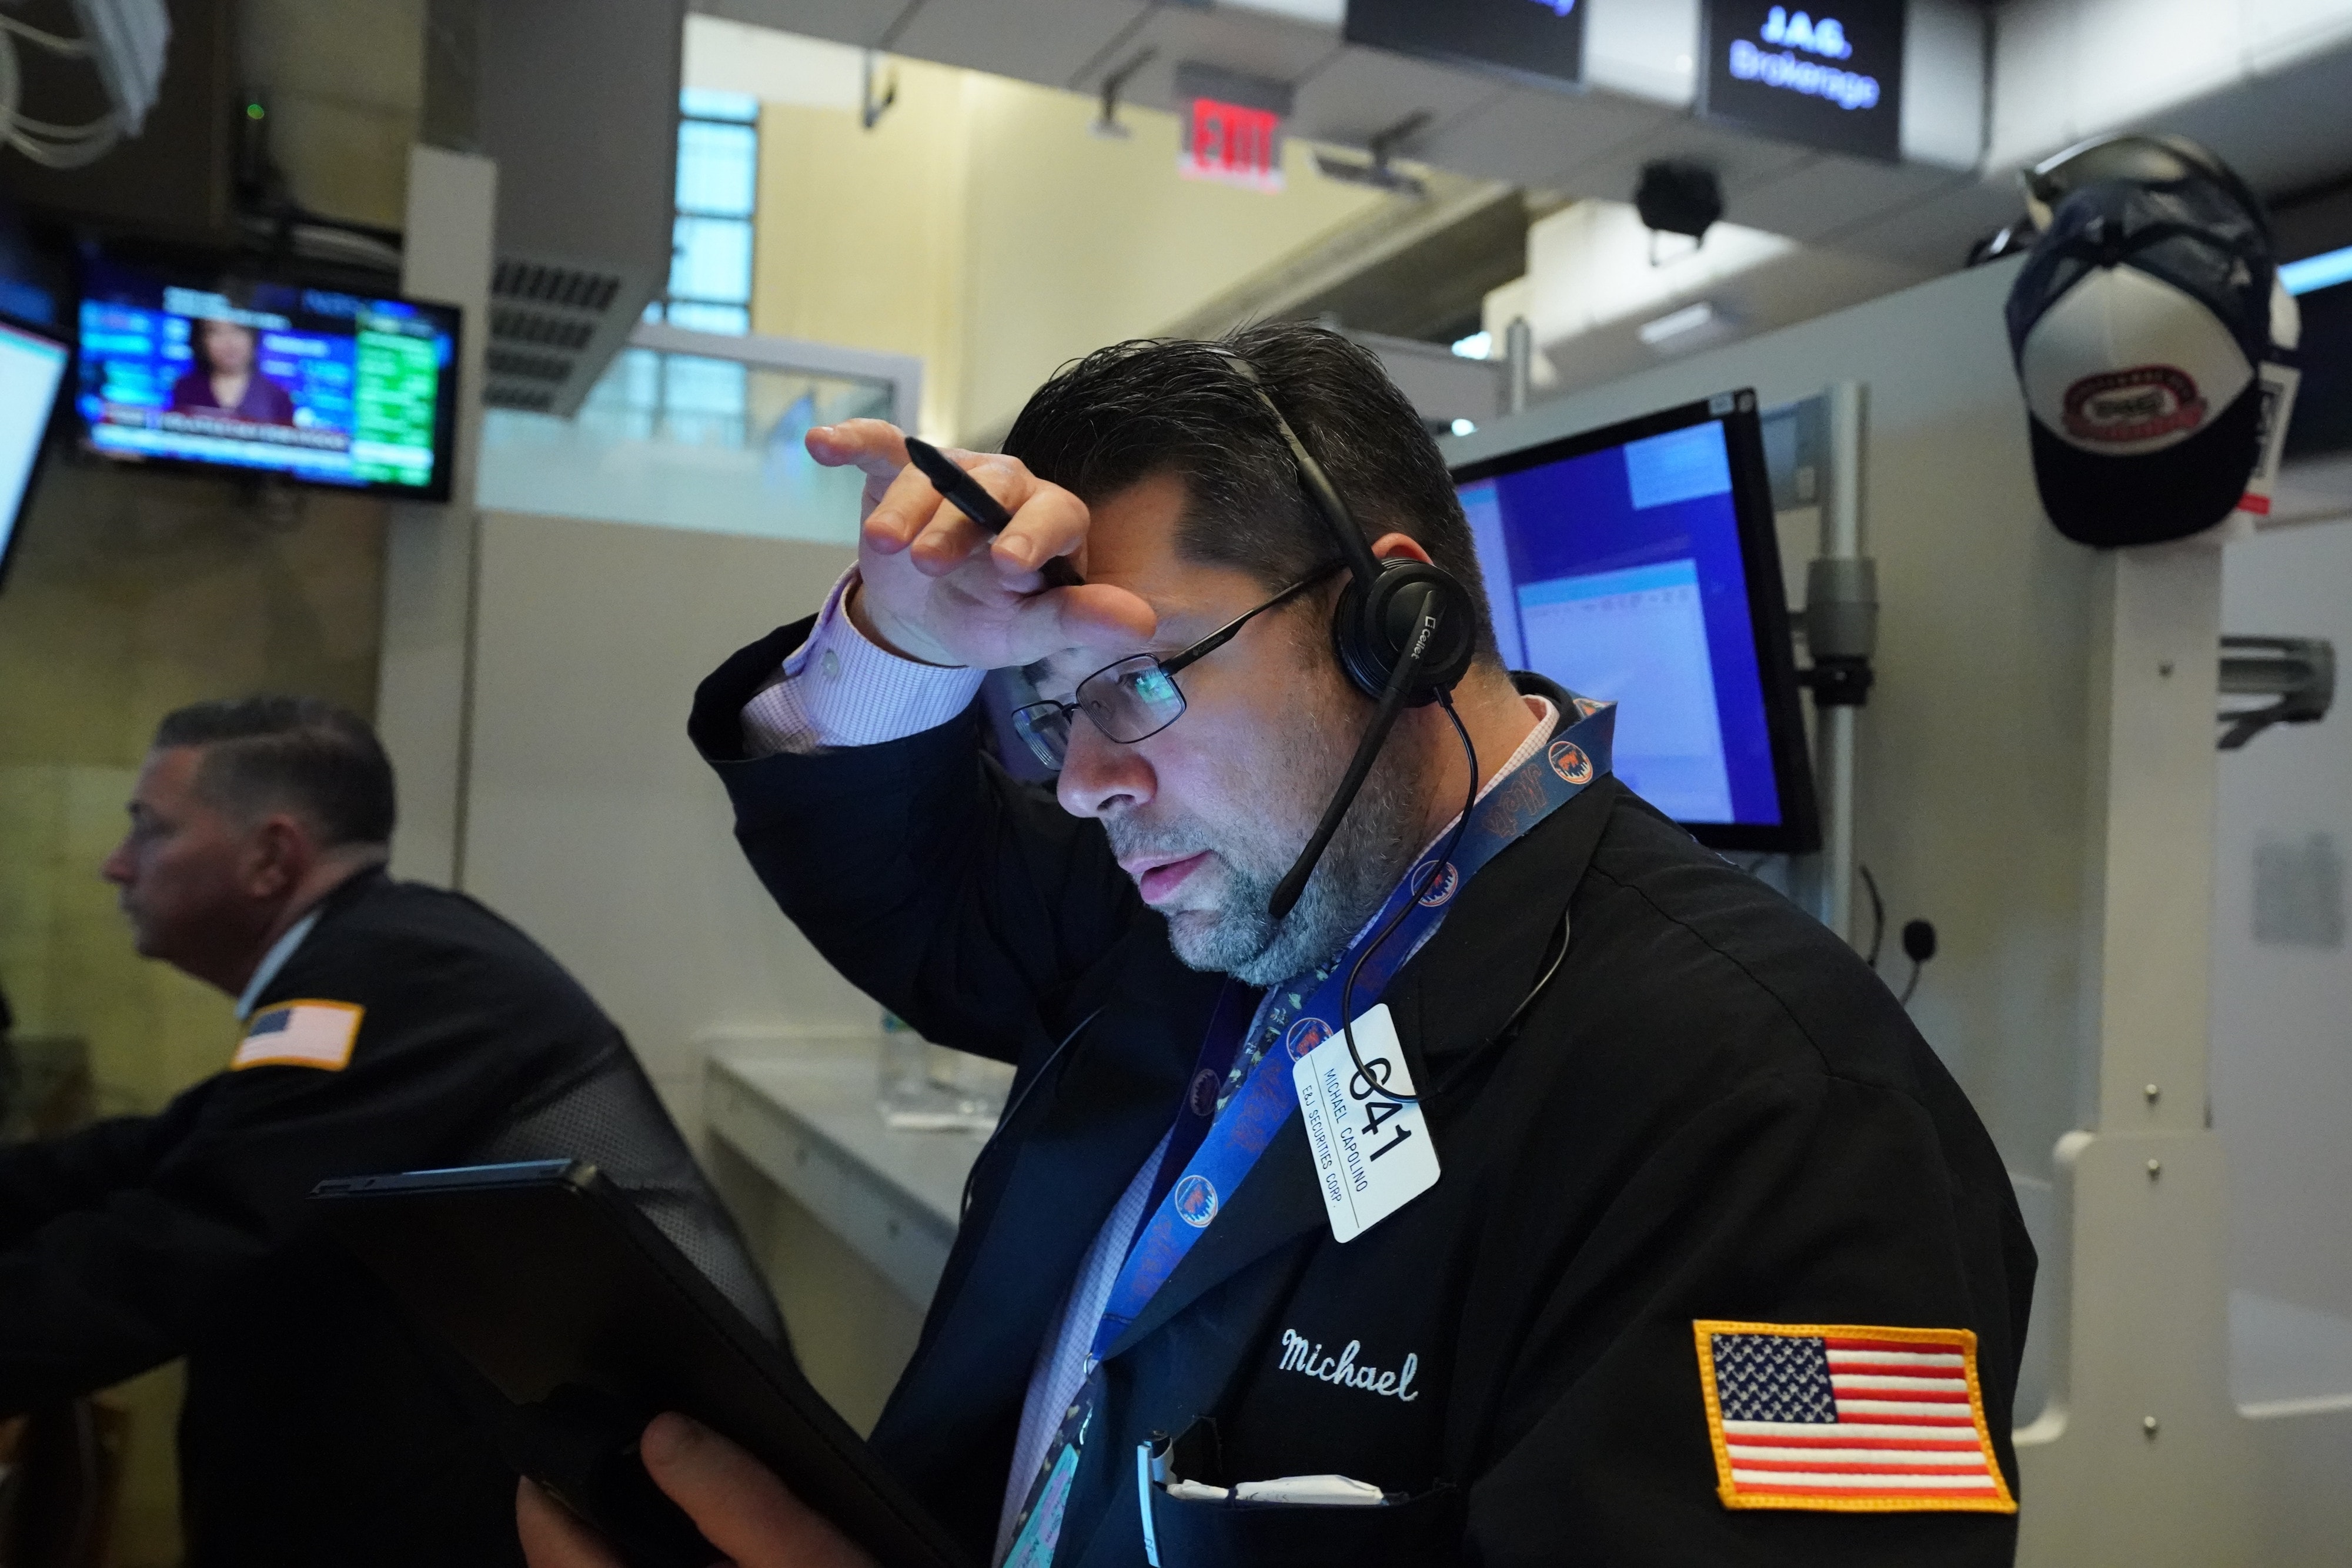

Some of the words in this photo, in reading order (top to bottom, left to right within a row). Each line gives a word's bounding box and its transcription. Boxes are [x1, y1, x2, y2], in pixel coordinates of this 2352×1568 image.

[1729, 39, 1880, 110] Brokerage
[1194, 98, 1278, 176] EXIT
[1411, 629, 1431, 660] cellet
[1302, 1085, 1313, 1106] E&J
[1308, 1109, 1332, 1169] SECURITIES
[1324, 1068, 1347, 1124] MICHAEL
[1340, 1126, 1368, 1192] CAPOLINO
[1349, 1058, 1412, 1162] 641
[1279, 1329, 1418, 1402] Michael
